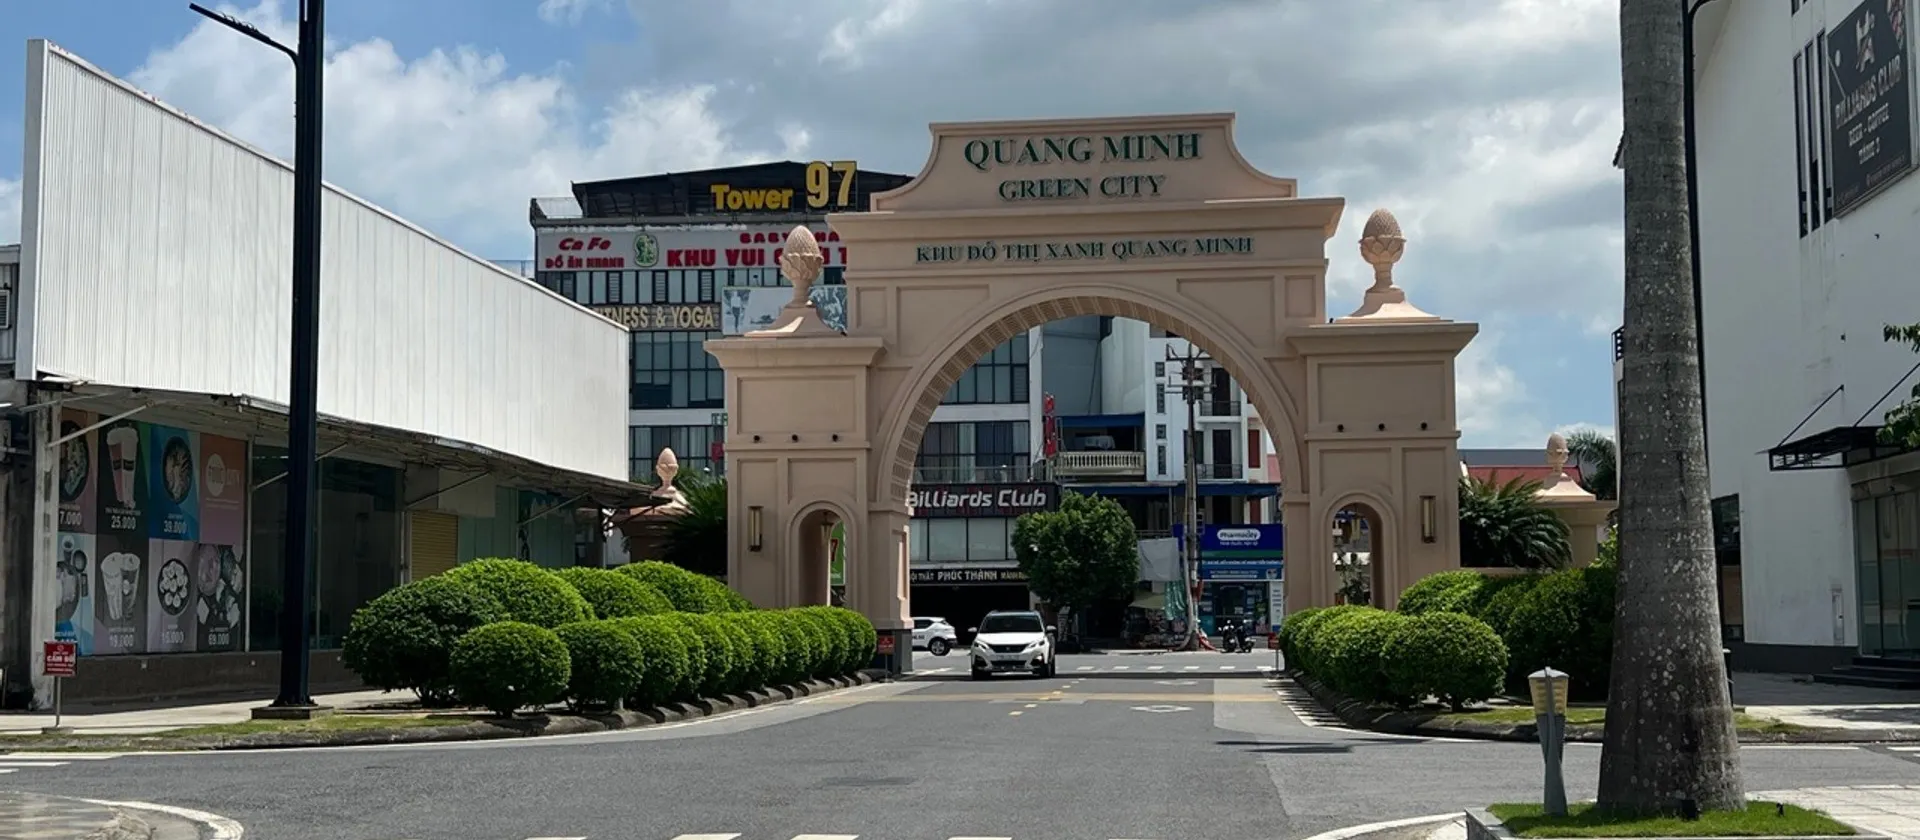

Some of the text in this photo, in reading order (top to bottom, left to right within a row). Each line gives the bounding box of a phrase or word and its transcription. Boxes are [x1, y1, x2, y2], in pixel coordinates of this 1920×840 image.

[1878, 54, 1901, 96] CLUB
[963, 133, 1202, 172] QUANG MINH
[711, 160, 857, 210] Tower 97
[998, 174, 1166, 201] GREEN CITY
[667, 248, 716, 267] KHU
[725, 248, 765, 267] VUI
[916, 242, 963, 264] KHU
[1003, 242, 1041, 263] THỊ
[1045, 241, 1105, 261] XANH
[1111, 240, 1187, 260] QUANG
[1193, 237, 1255, 257] MINH
[655, 306, 666, 328] &
[670, 306, 714, 329] YOGA
[906, 489, 1046, 507] Billiards Club
[111, 515, 136, 530] 25.000
[937, 570, 962, 582] PHÚC
